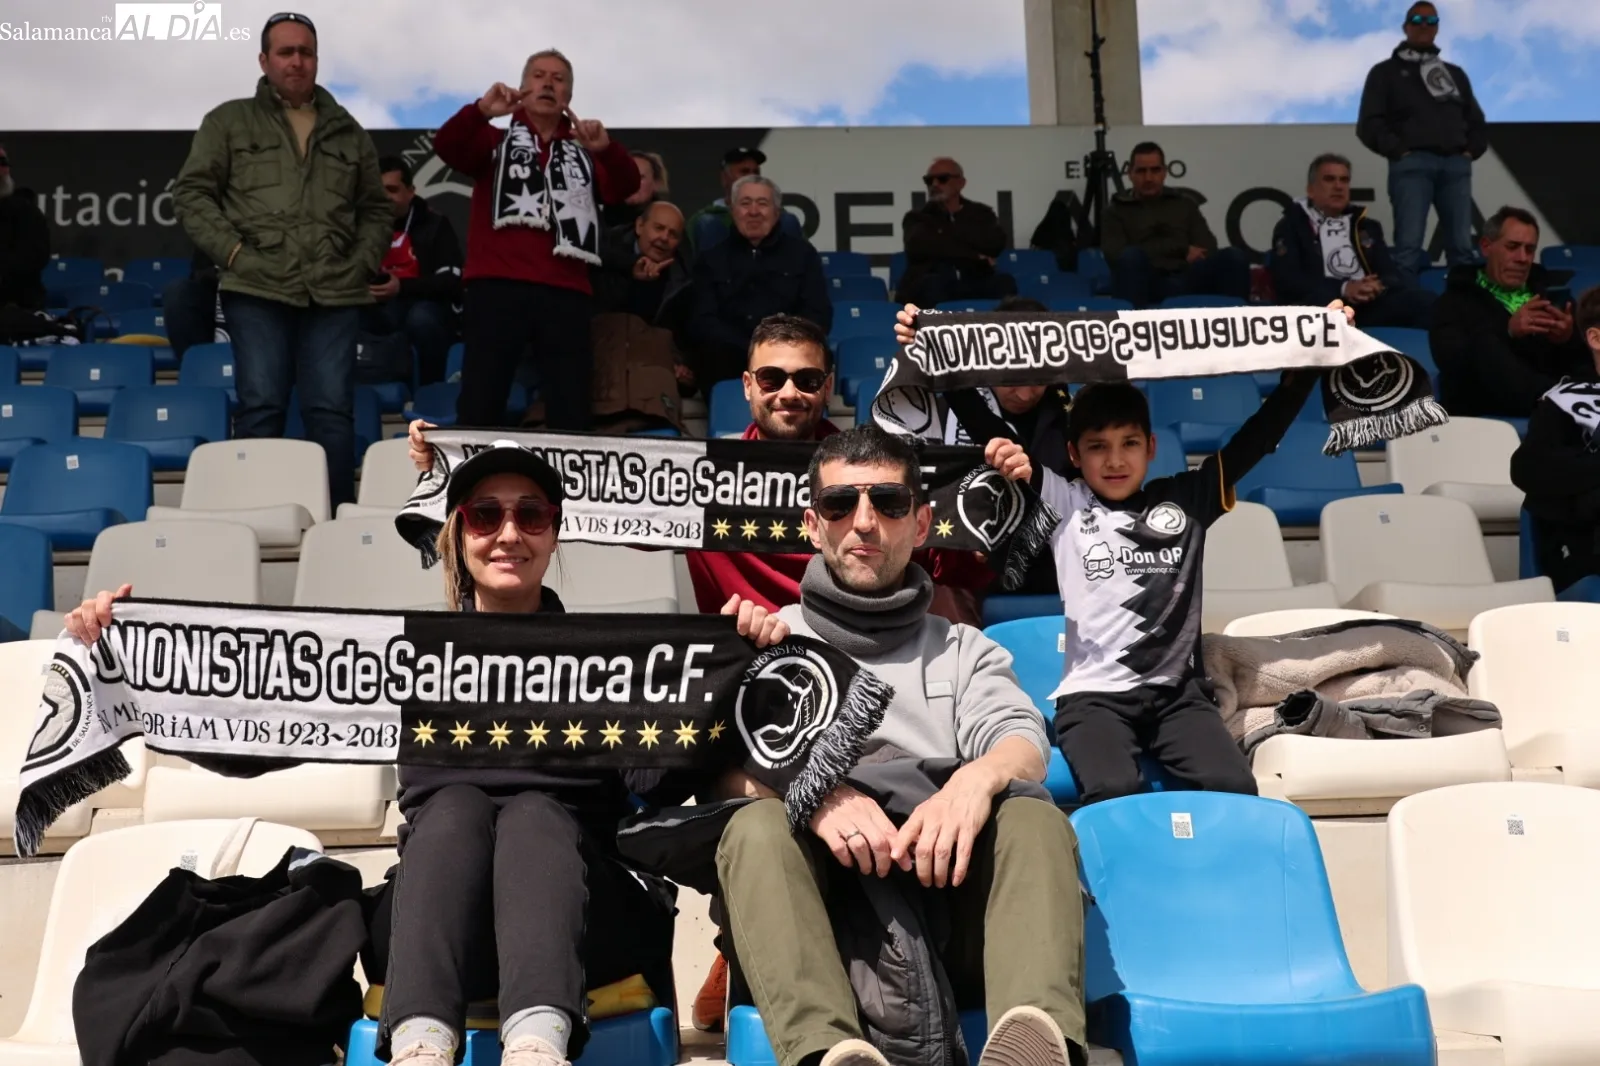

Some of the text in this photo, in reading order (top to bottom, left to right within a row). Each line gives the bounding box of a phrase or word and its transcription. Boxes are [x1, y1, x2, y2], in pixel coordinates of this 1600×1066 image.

[649, 458, 690, 506] de
[693, 457, 812, 508] Salama
[574, 516, 608, 534] VDS
[1120, 546, 1183, 565] Don QR
[91, 619, 715, 704] UNIONISTAS de Salamanca C.F.
[224, 718, 271, 743] VDS
